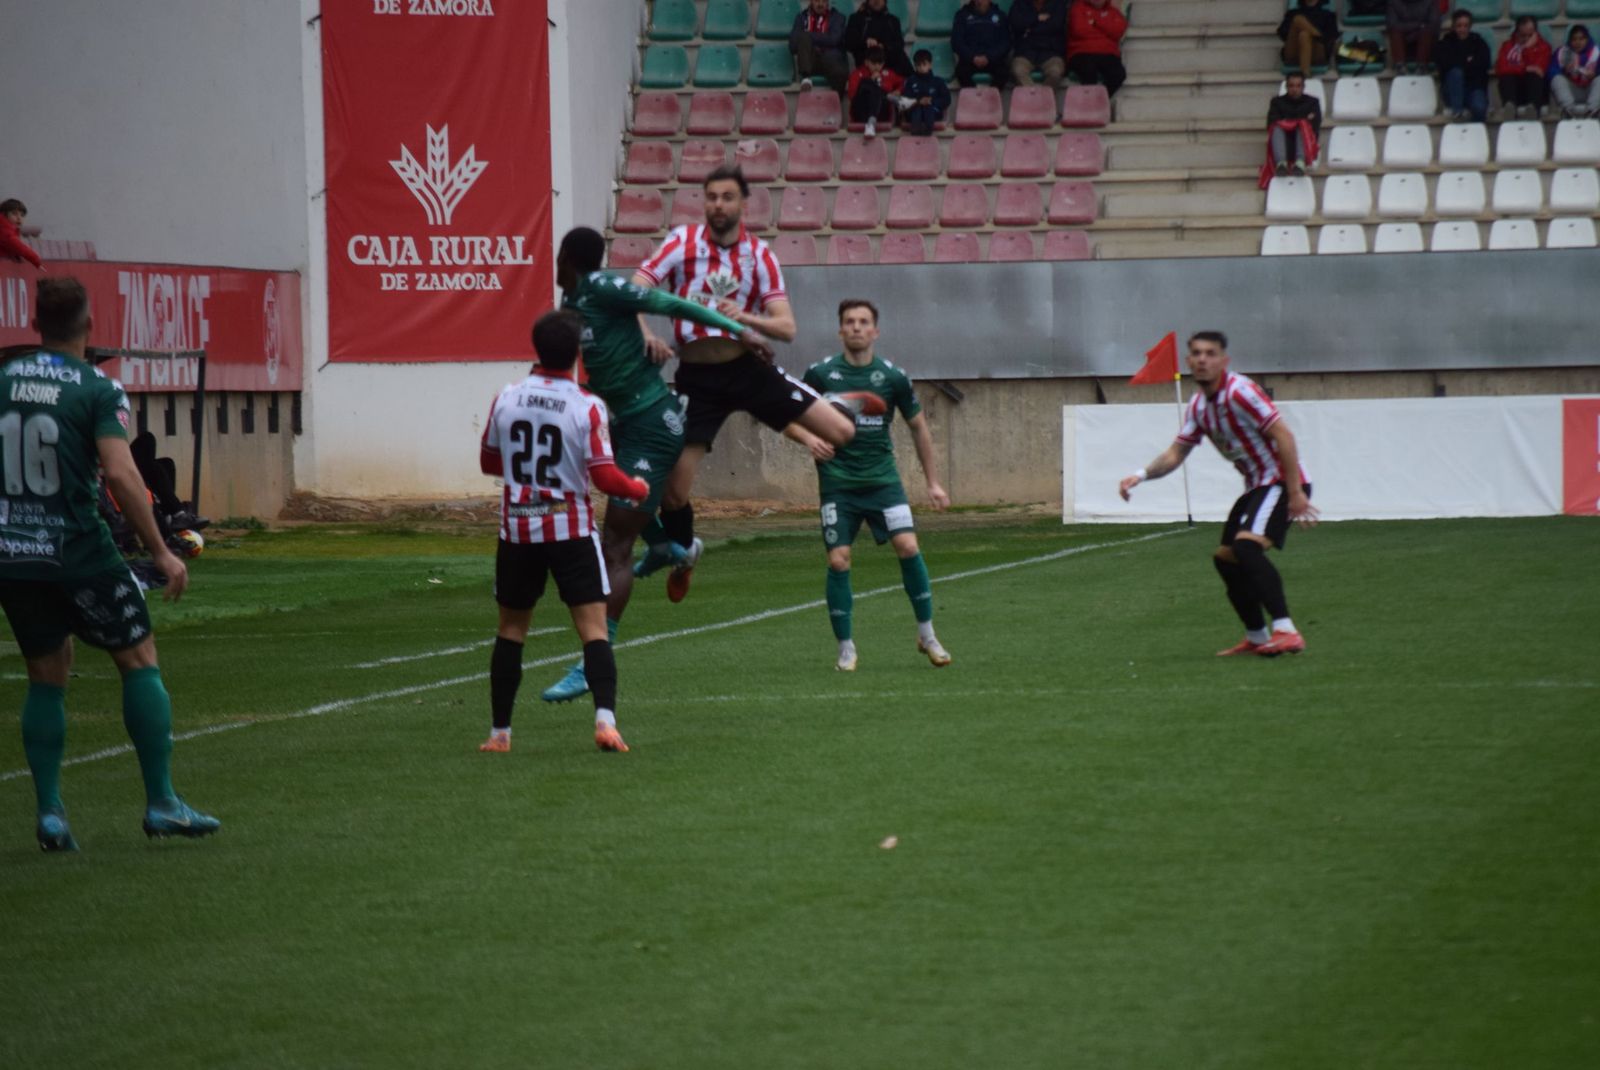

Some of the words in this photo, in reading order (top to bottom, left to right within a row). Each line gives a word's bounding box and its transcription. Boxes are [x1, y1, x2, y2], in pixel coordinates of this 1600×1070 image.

[373, 0, 402, 15] DE
[408, 0, 495, 16] ZAMORA
[347, 235, 423, 268] CAJA
[429, 236, 534, 266] RURAL
[380, 273, 408, 291] DE
[416, 273, 503, 291] ZAMORA
[6, 361, 82, 386] ABANCA
[11, 381, 61, 406] LASURE
[527, 394, 567, 414] SANCHO
[0, 412, 61, 497] 16
[510, 420, 563, 489] 22
[10, 514, 24, 525] DE
[12, 503, 46, 514] XUNTA
